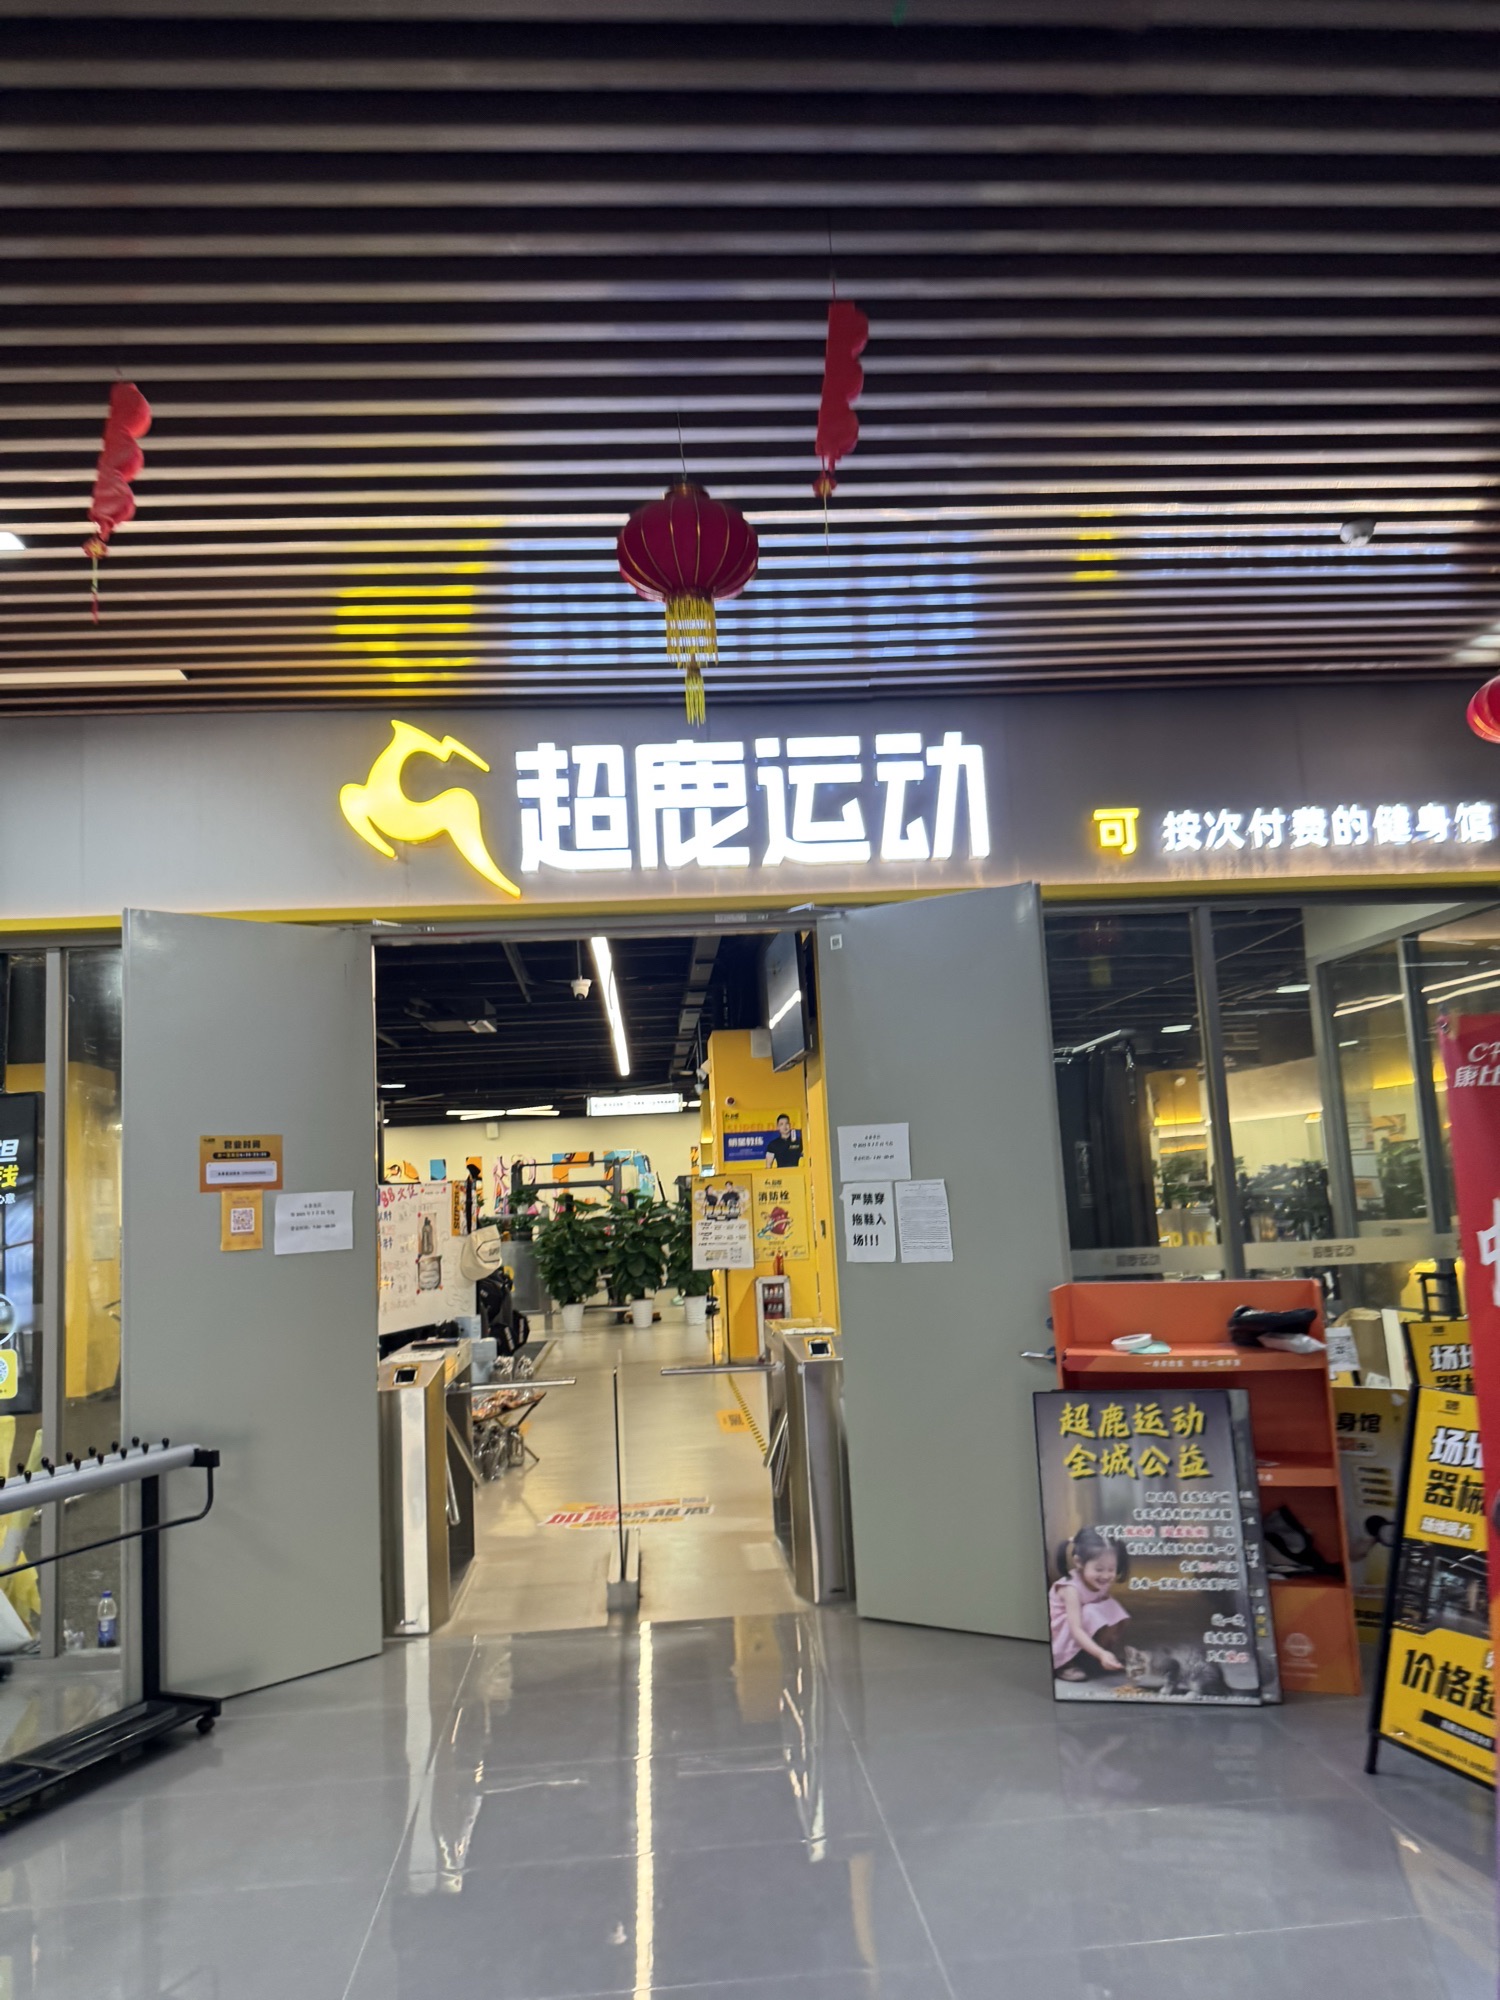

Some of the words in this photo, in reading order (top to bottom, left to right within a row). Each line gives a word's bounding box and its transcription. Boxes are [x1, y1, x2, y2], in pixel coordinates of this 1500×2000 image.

[515, 730, 993, 876] 超鹿运动
[1092, 806, 1141, 857] 可
[1161, 800, 1498, 853] 按次付费的健身馆
[758, 1190, 790, 1202] 消防栓
[851, 1192, 885, 1206] 严禁穿
[852, 1212, 887, 1226] 拖鞋入
[1058, 1402, 1206, 1439] 超鹿运动
[1062, 1444, 1211, 1480] 全城公益
